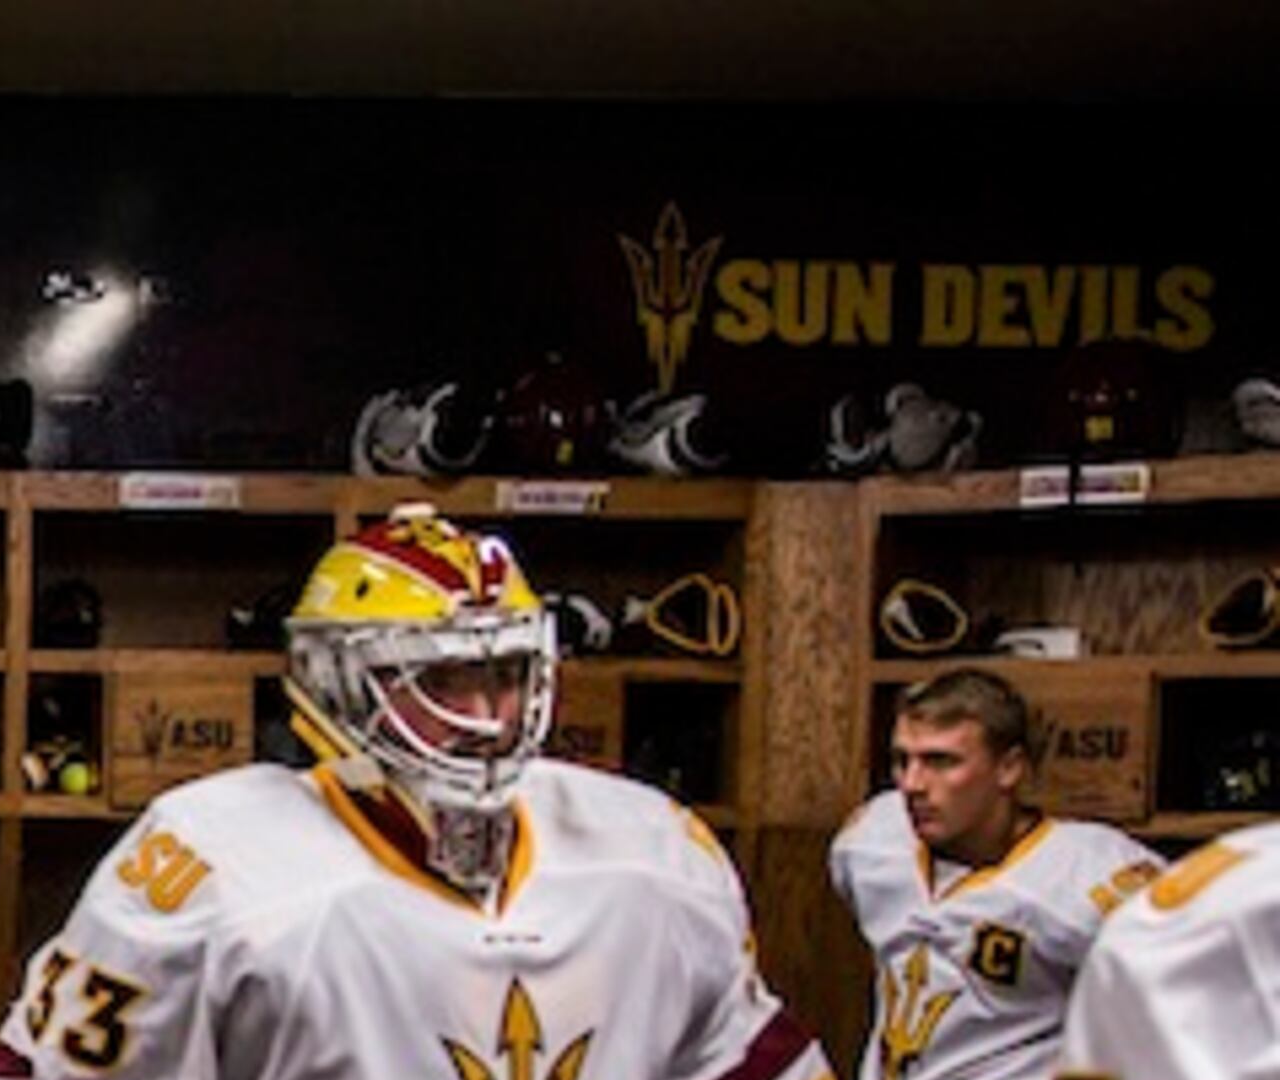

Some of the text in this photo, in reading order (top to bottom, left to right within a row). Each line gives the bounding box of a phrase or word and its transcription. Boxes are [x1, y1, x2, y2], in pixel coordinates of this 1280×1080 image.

[713, 259, 1216, 352] SUN DEVILS
[169, 719, 234, 751] ASU
[1057, 726, 1128, 760] ASU
[981, 932, 1016, 976] C
